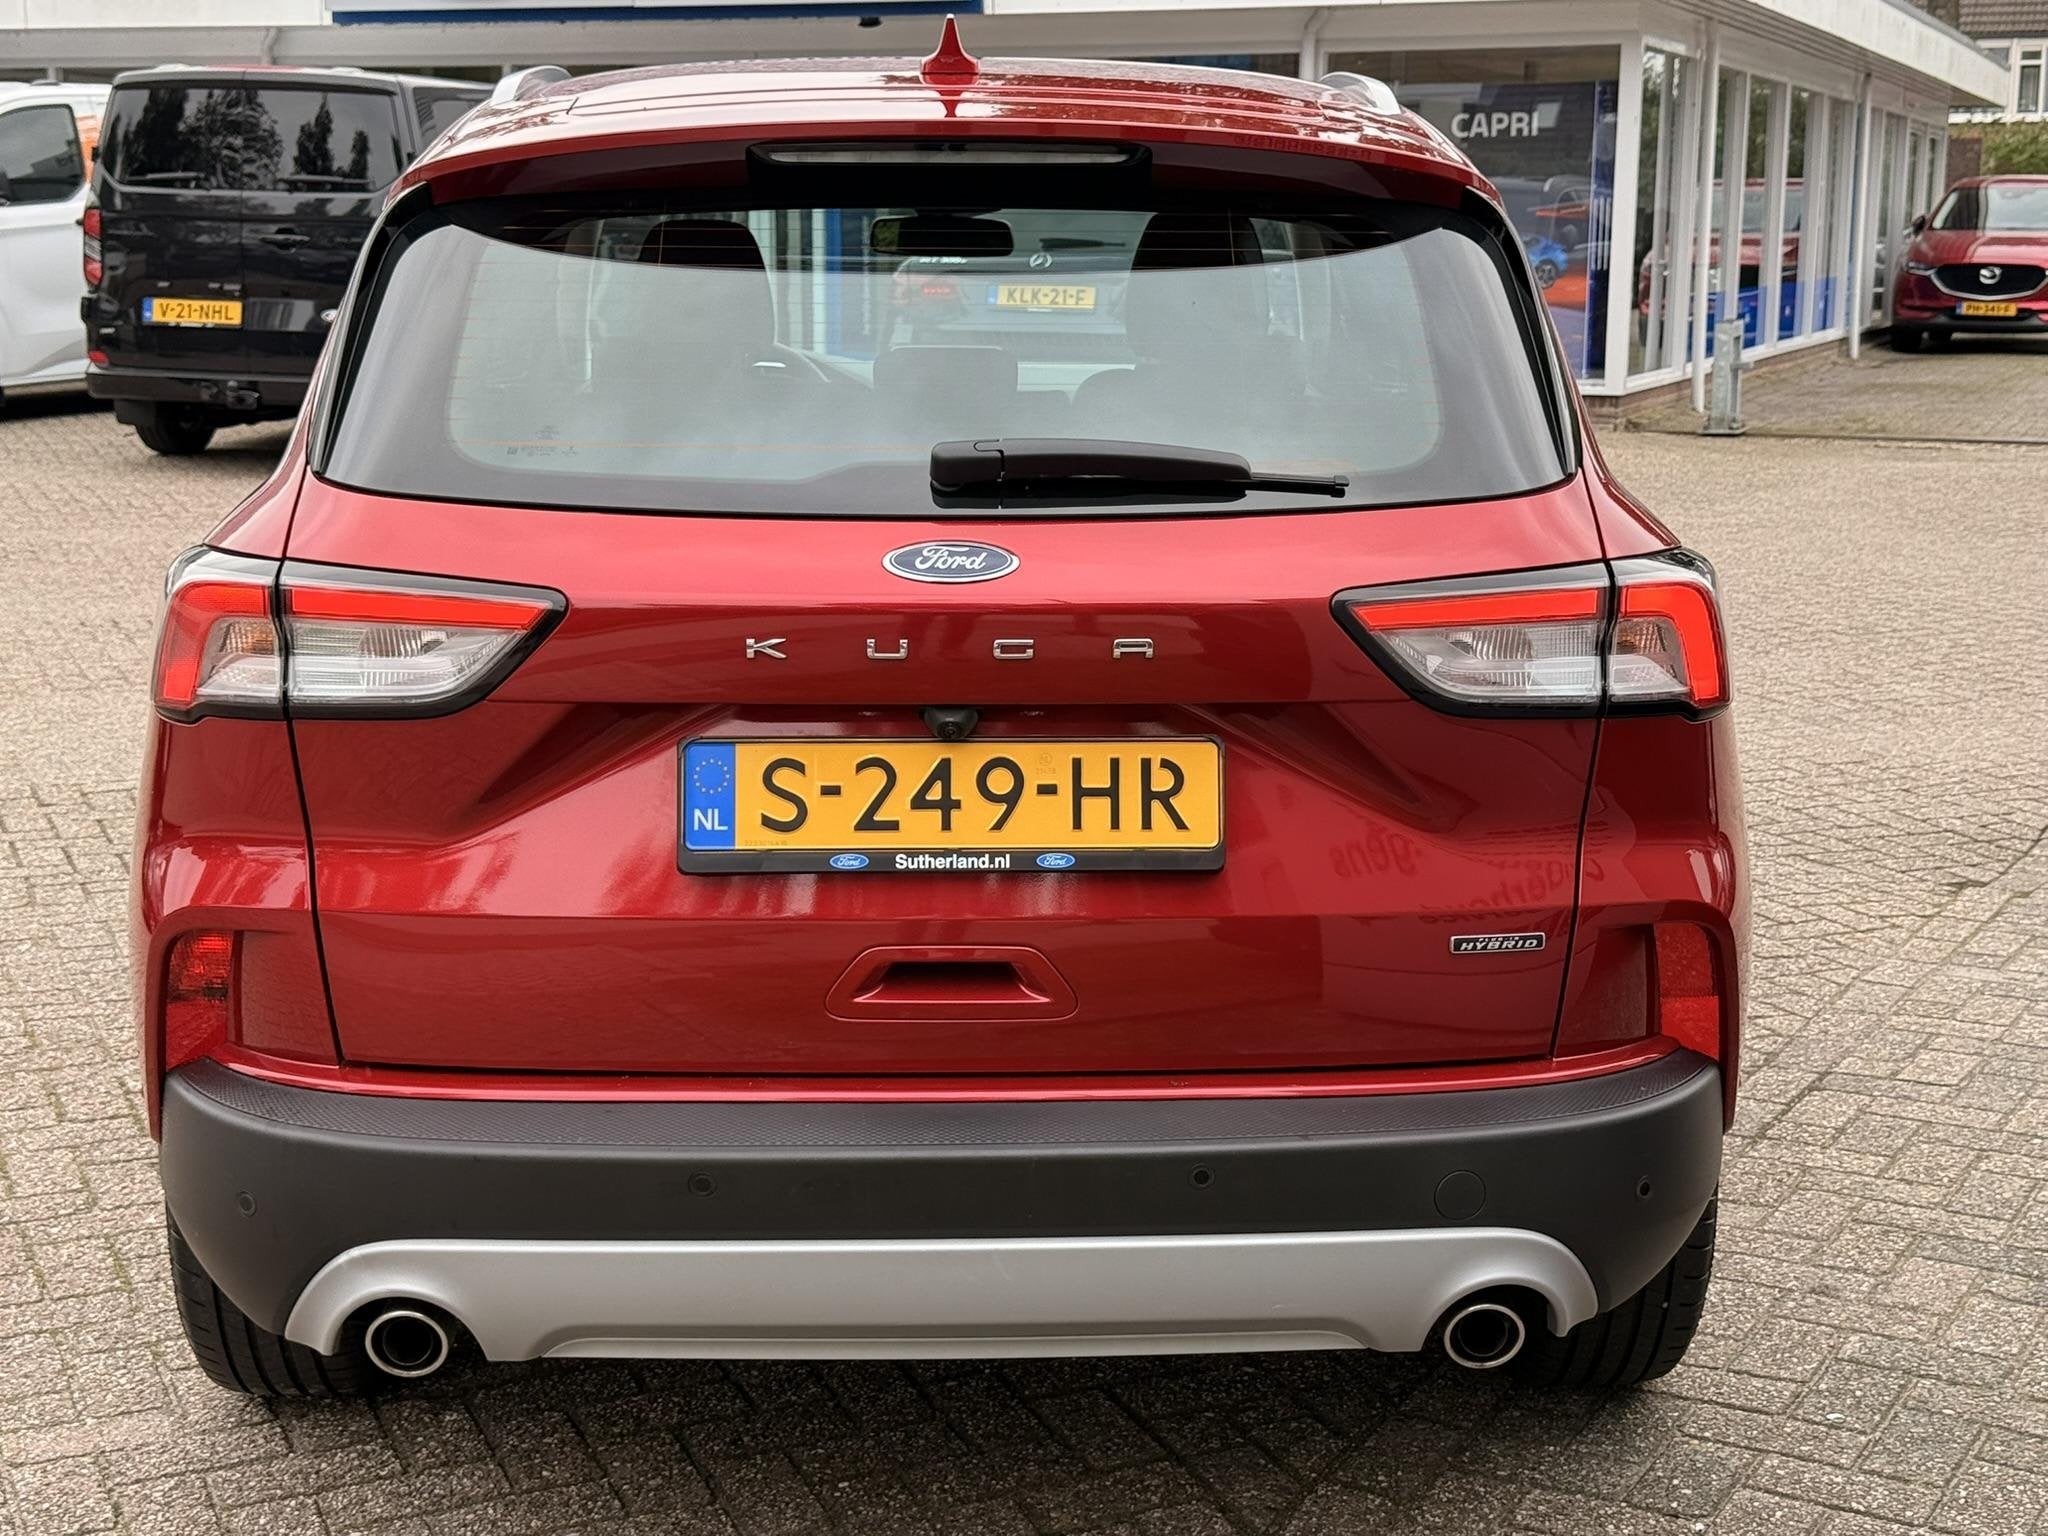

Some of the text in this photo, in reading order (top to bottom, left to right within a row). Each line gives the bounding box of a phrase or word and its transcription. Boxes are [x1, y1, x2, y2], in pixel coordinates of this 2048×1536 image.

[1451, 111, 1540, 138] CAPRI
[1006, 287, 1087, 306] KLK-21-F
[159, 302, 235, 320] V-21-NHL
[915, 545, 988, 570] Ford
[745, 637, 1155, 660] KUGA
[760, 756, 1191, 833] S-249-HR
[693, 808, 728, 832] NL
[895, 853, 1011, 869] Sutherland.nl
[1460, 939, 1538, 951] HYBRID
